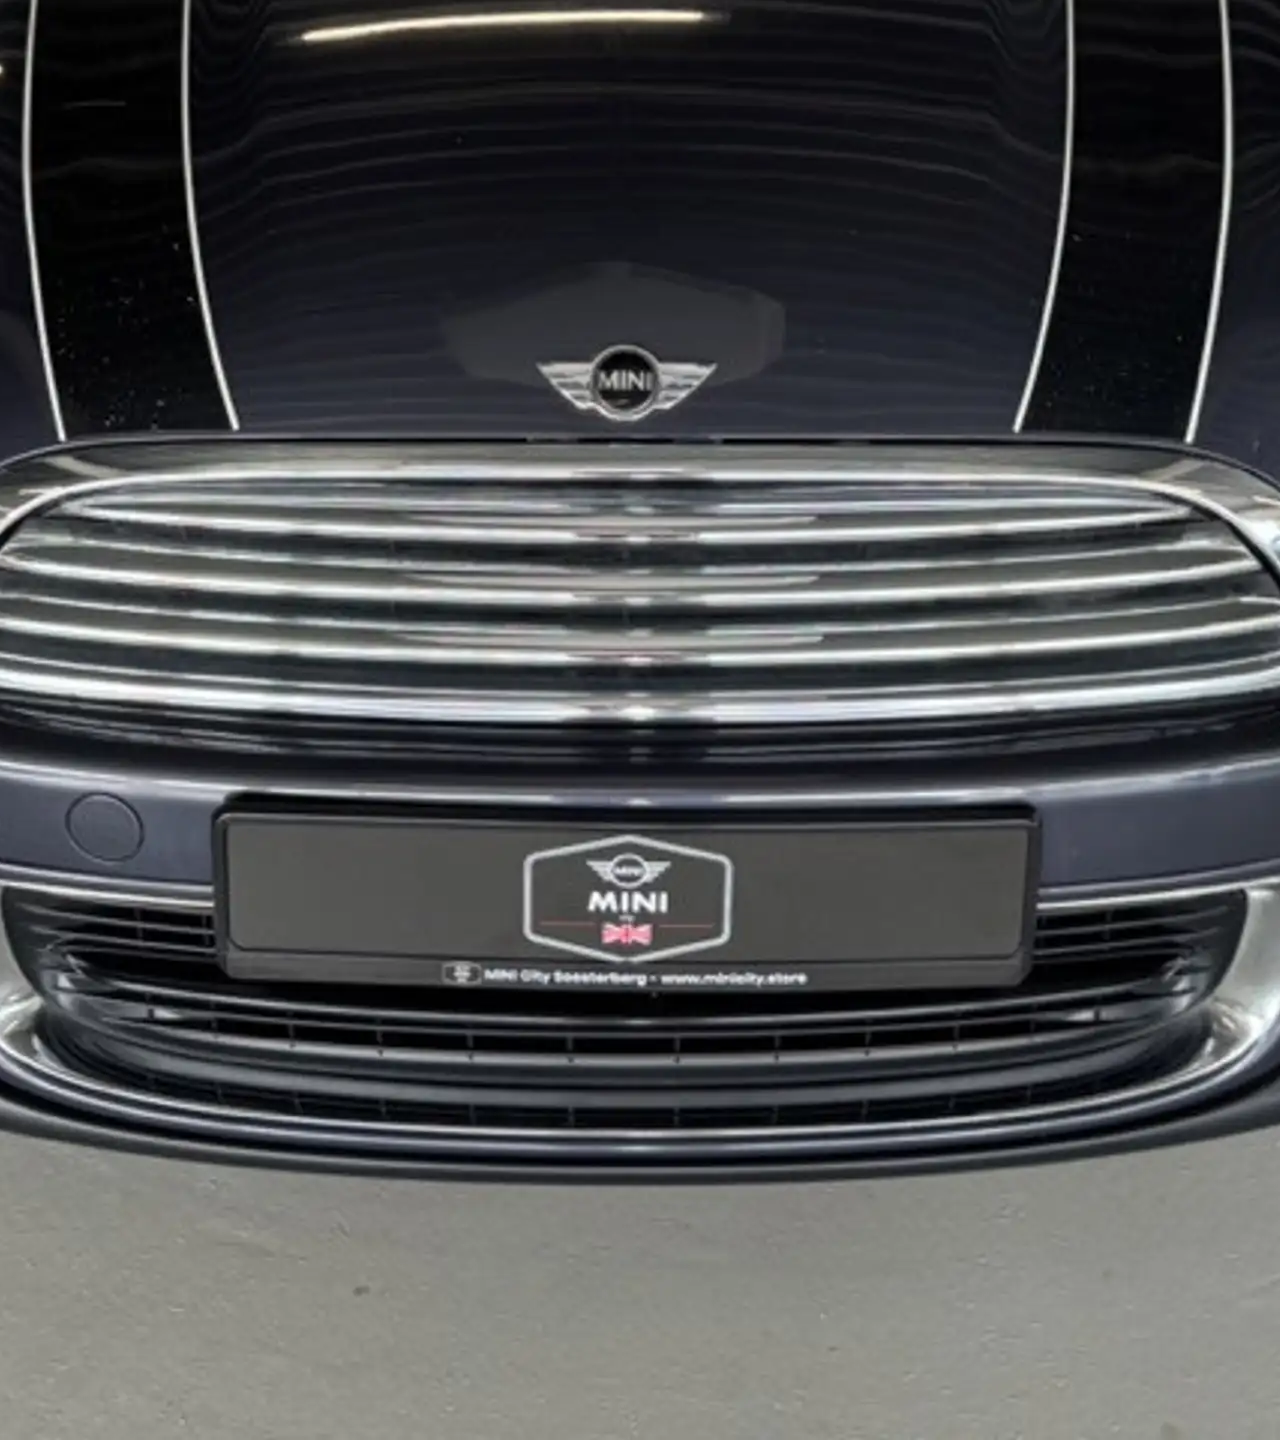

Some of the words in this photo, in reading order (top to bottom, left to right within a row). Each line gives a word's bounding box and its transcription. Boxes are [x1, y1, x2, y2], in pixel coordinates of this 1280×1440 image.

[597, 369, 655, 392] MINI
[586, 890, 669, 914] MINI
[483, 968, 519, 981] MINI
